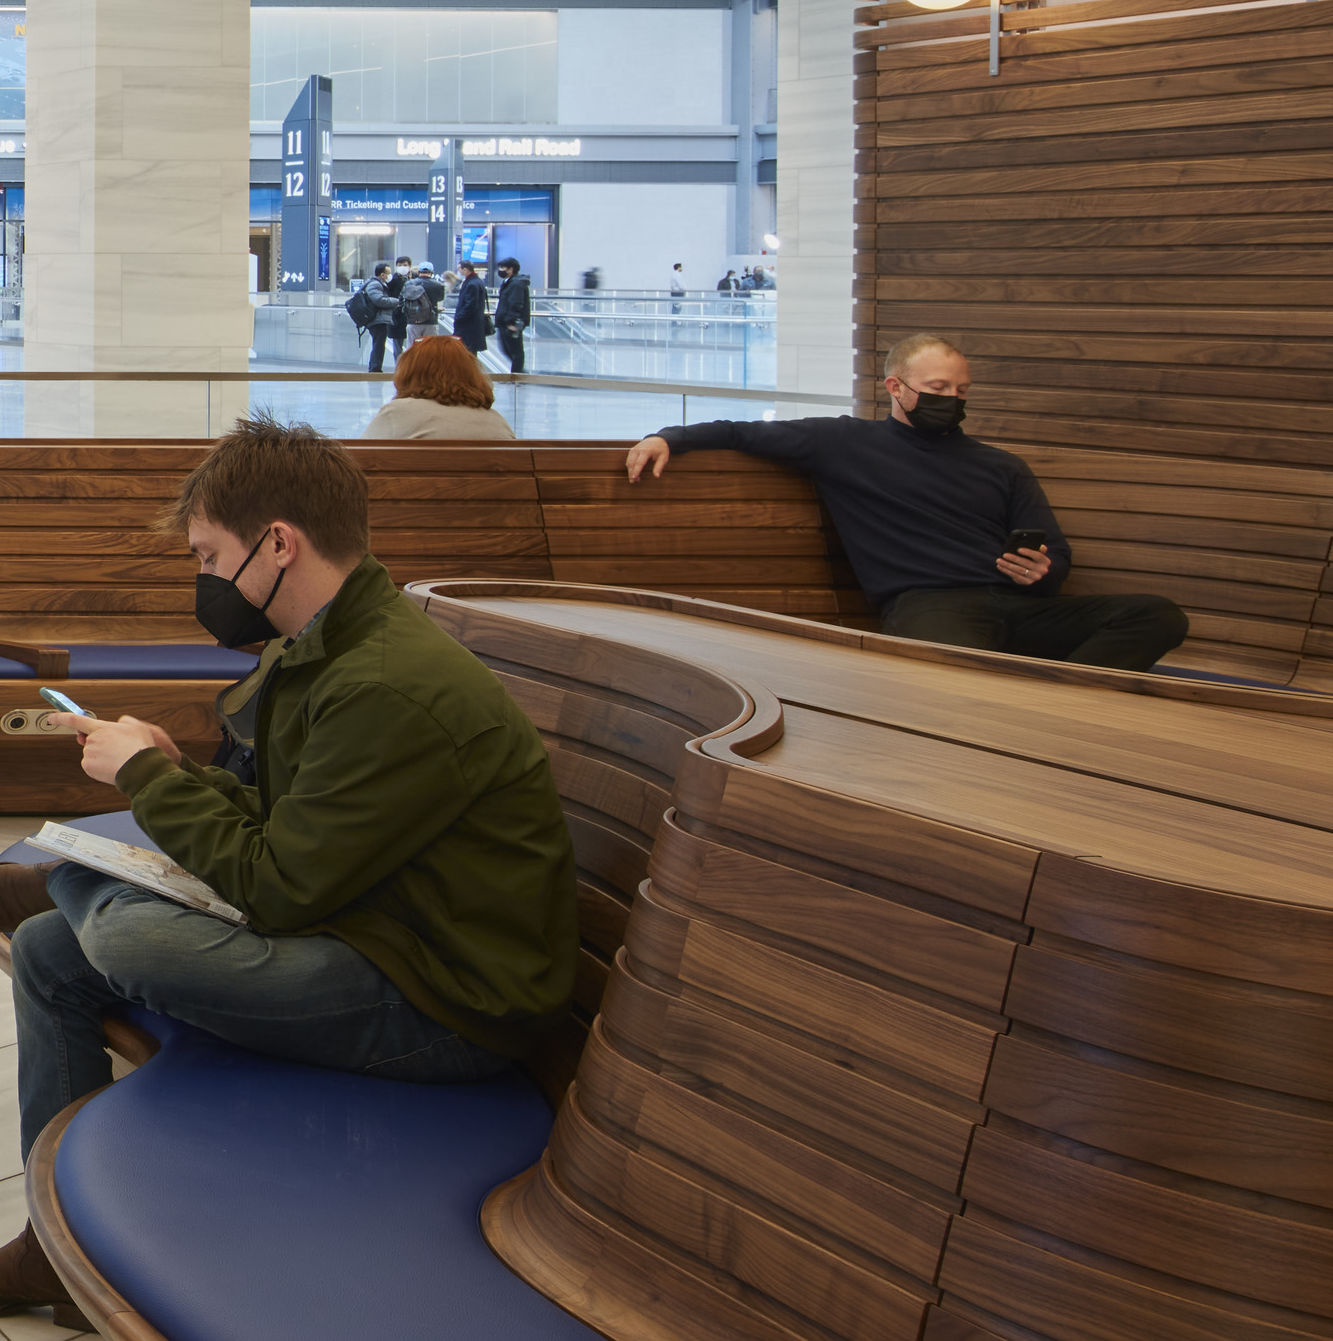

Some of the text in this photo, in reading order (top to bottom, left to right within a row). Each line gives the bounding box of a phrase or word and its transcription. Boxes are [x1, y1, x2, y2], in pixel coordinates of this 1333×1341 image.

[15, 24, 26, 35] N
[287, 130, 302, 155] 11
[322, 130, 330, 154] 11
[397, 138, 441, 159] Long
[498, 138, 533, 156] Rail
[535, 138, 581, 156] Road
[285, 172, 304, 197] 12
[321, 172, 331, 197] 12
[432, 175, 445, 193] 13
[345, 200, 382, 210] Ticketing
[385, 200, 401, 209] and
[431, 205, 445, 222] 14
